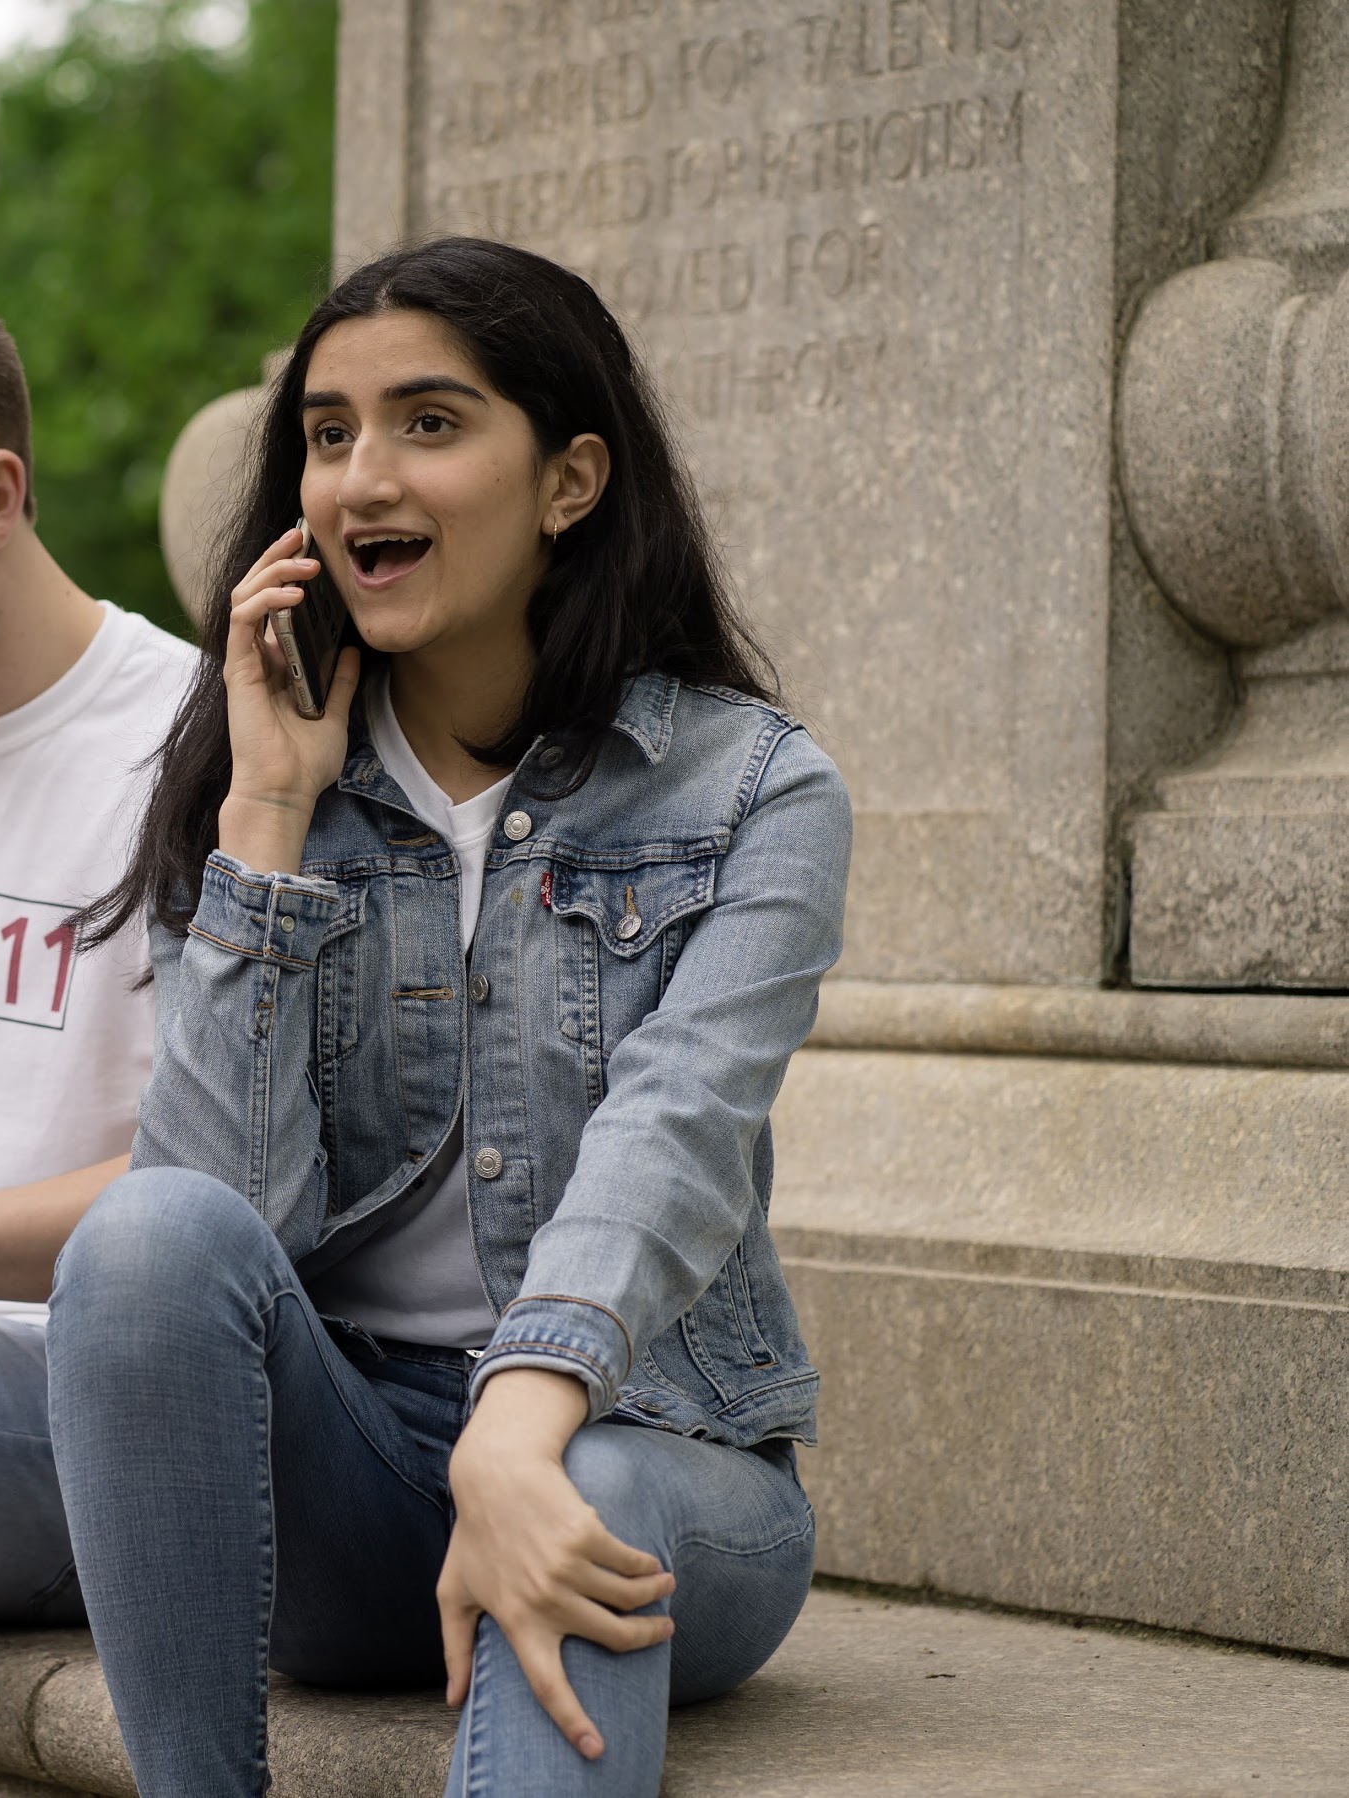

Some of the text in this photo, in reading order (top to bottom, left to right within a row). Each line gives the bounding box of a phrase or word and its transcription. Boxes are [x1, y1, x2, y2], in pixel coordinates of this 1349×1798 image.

[674, 25, 765, 112] FOR
[663, 136, 745, 218] FOR
[755, 90, 1025, 204] PATRIOTISM
[784, 222, 885, 306] FOR
